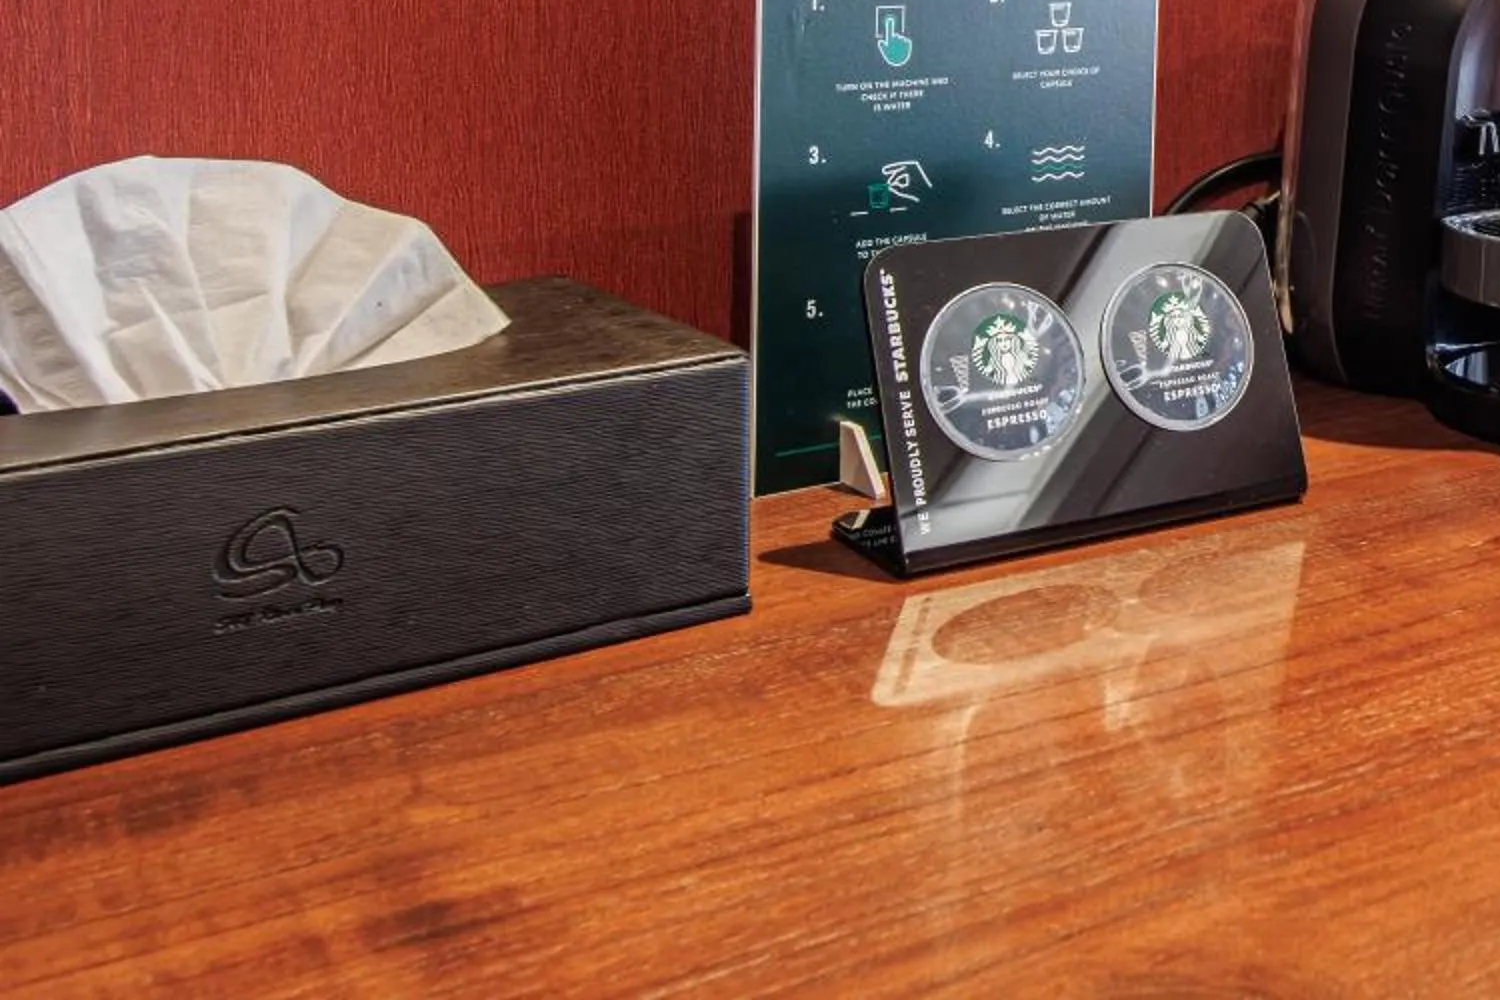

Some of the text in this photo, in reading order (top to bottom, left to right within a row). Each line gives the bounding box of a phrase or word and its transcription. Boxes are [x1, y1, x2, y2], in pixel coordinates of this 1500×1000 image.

[984, 129, 1001, 149] 4.
[809, 144, 827, 165] 3.
[806, 298, 823, 319] 5.
[1163, 382, 1221, 402] ESPRESSO
[880, 272, 932, 536] WE PROUDLY SERVE STARBUCKS
[986, 408, 1047, 432] ESPRESSO
